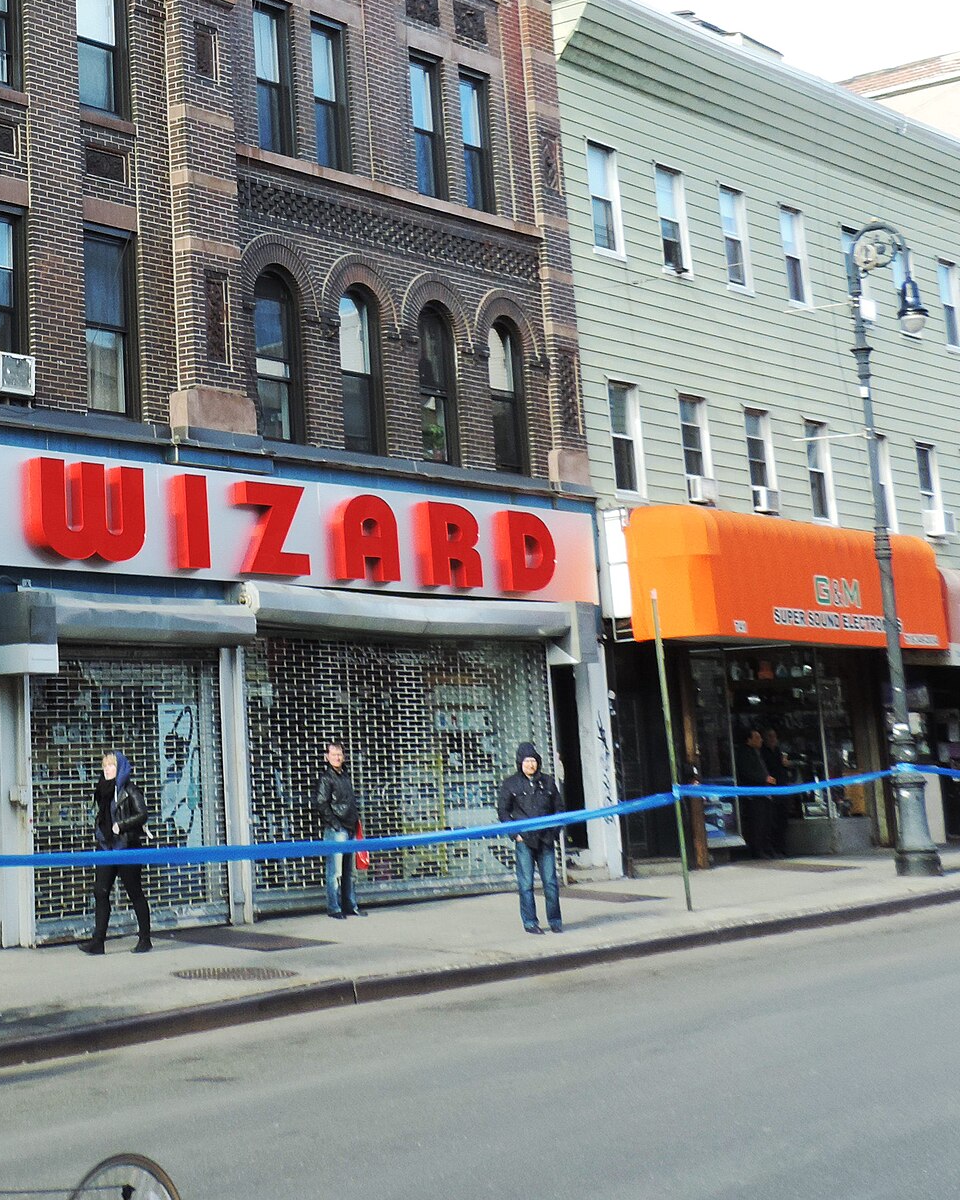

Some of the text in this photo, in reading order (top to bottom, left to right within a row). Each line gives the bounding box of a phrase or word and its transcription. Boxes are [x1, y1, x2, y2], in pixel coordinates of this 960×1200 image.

[22, 456, 557, 593] WIZARD
[813, 574, 863, 610] G&M
[773, 607, 903, 635] SUPER SOUND ELECTROS
